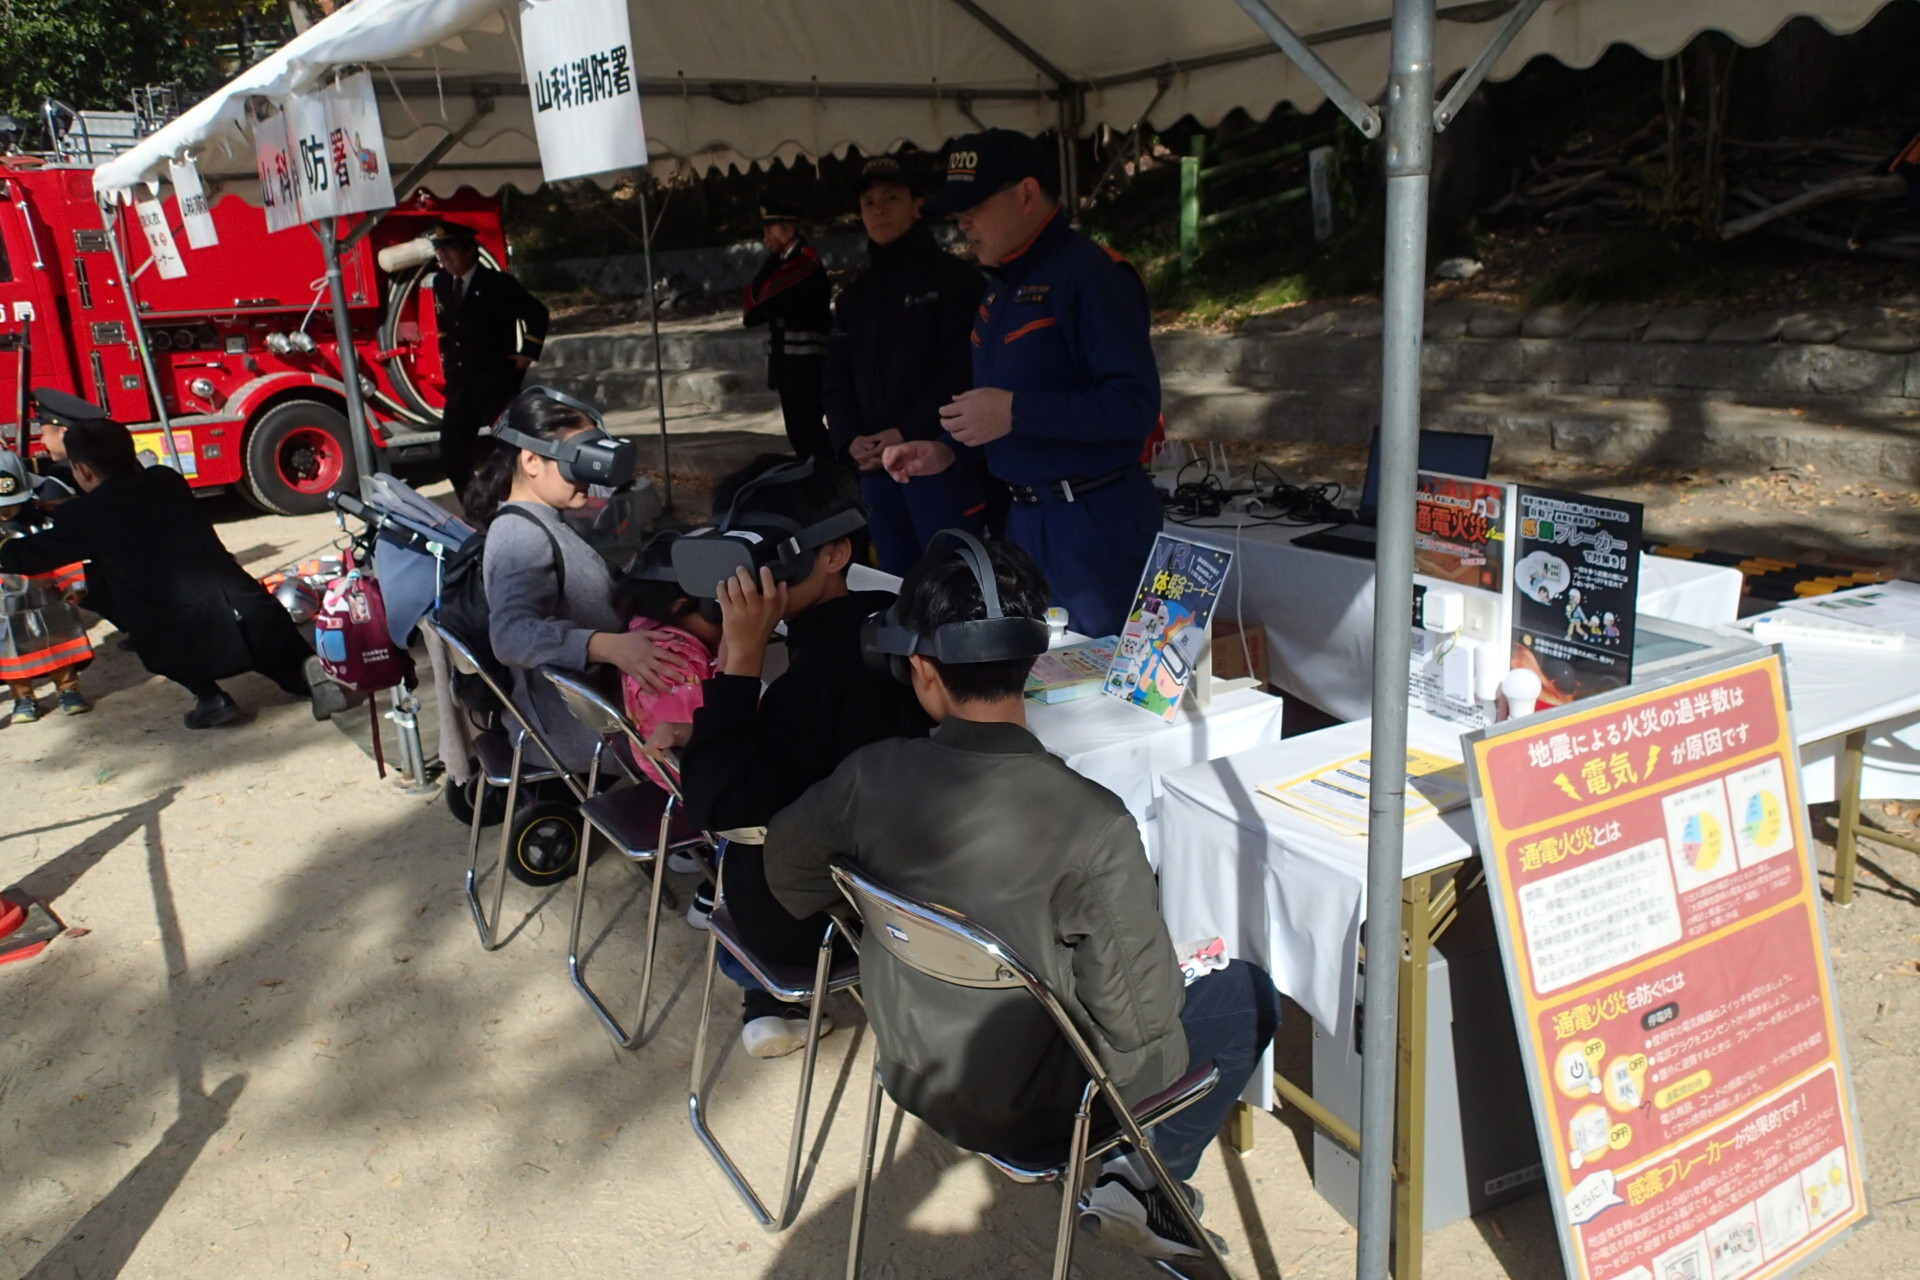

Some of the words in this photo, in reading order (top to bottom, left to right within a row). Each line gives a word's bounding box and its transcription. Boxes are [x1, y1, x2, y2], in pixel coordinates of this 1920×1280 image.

[535, 45, 631, 113] 山科消防署
[1156, 543, 1191, 570] VR
[1520, 518, 1628, 554] 感震ブレーカー
[1151, 569, 1217, 601] 体験コーナー
[1528, 686, 1745, 768] 地震による火災の過半数は
[1581, 751, 1638, 796] 電気
[1671, 723, 1750, 766] が原因です
[1518, 820, 1622, 873] 通電火災とは
[1552, 971, 1686, 1041] 通電火災を防ぐには
[1626, 1092, 1808, 1207] 感震ブレーカーが効果的です！
